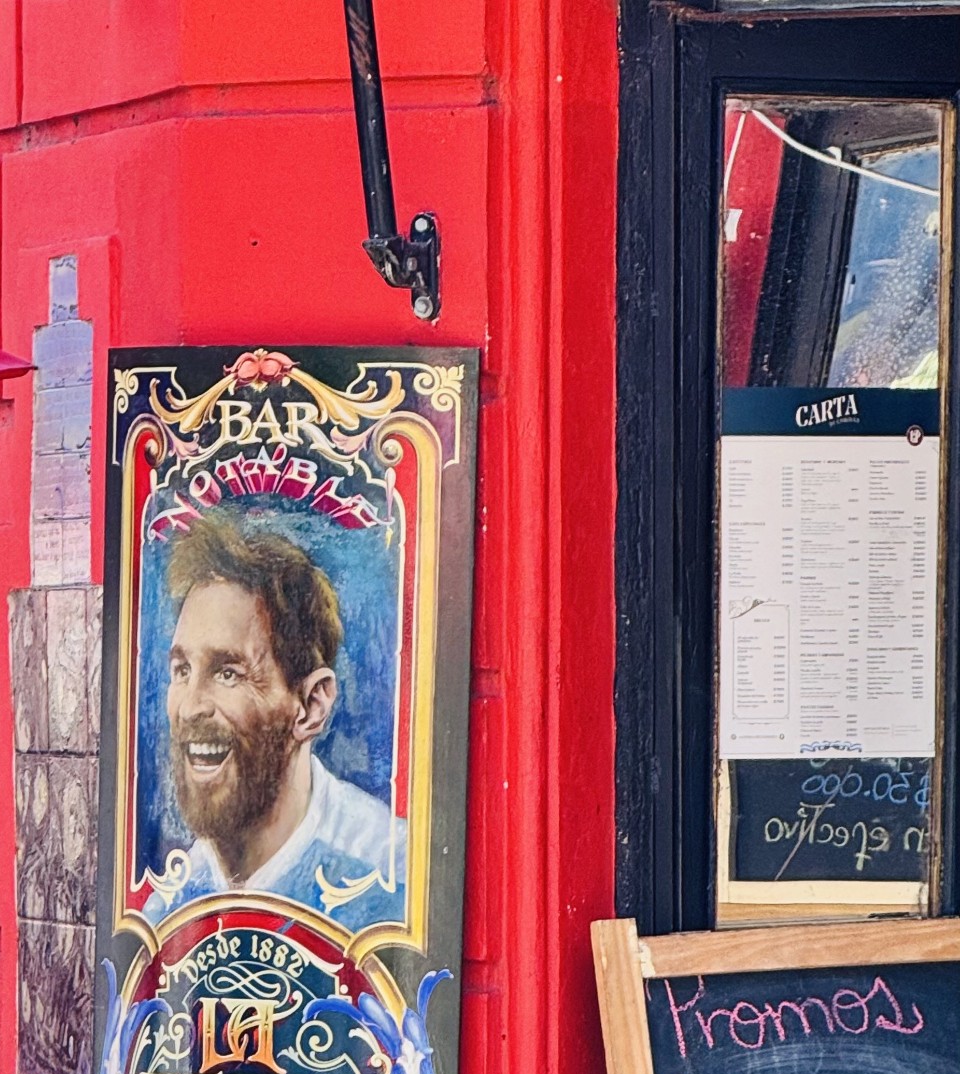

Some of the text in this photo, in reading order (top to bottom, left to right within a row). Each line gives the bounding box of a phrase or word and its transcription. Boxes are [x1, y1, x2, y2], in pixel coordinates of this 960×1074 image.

[200, 398, 346, 456] BAR
[795, 394, 858, 427] CARTA
[250, 934, 304, 978] 1882
[198, 991, 302, 1074] LA
[648, 975, 924, 1058] Promos
